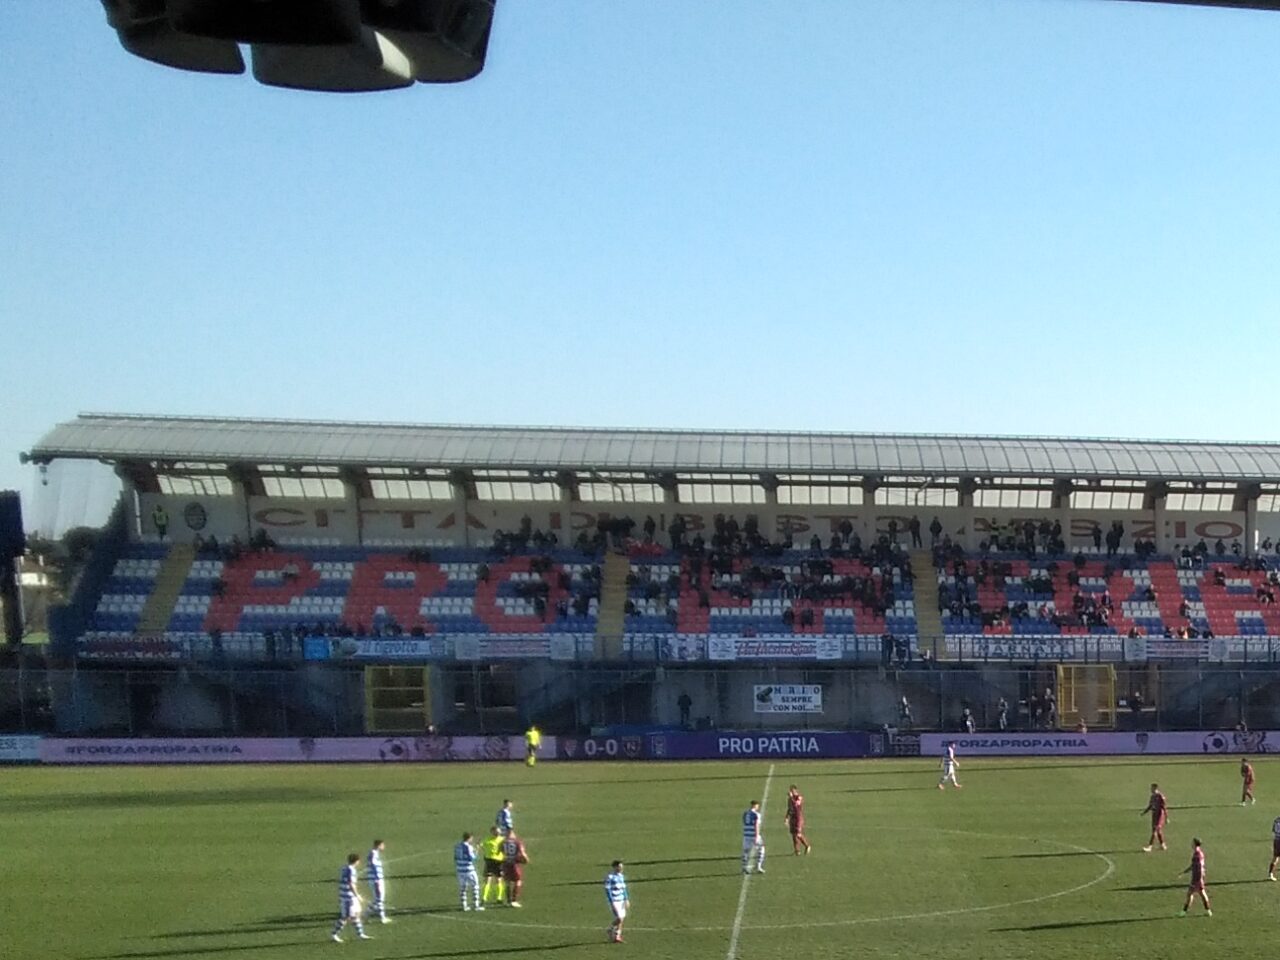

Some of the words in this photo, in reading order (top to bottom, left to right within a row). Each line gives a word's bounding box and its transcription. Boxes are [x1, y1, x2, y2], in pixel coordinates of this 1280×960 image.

[204, 553, 574, 634] PRO
[781, 695, 813, 704] SEMPRE
[772, 704, 790, 712] CON
[64, 743, 243, 755] #FORZAPROPATRIA
[584, 739, 618, 756] 0-0
[718, 736, 754, 754] PRO
[757, 735, 819, 754] PATRIA
